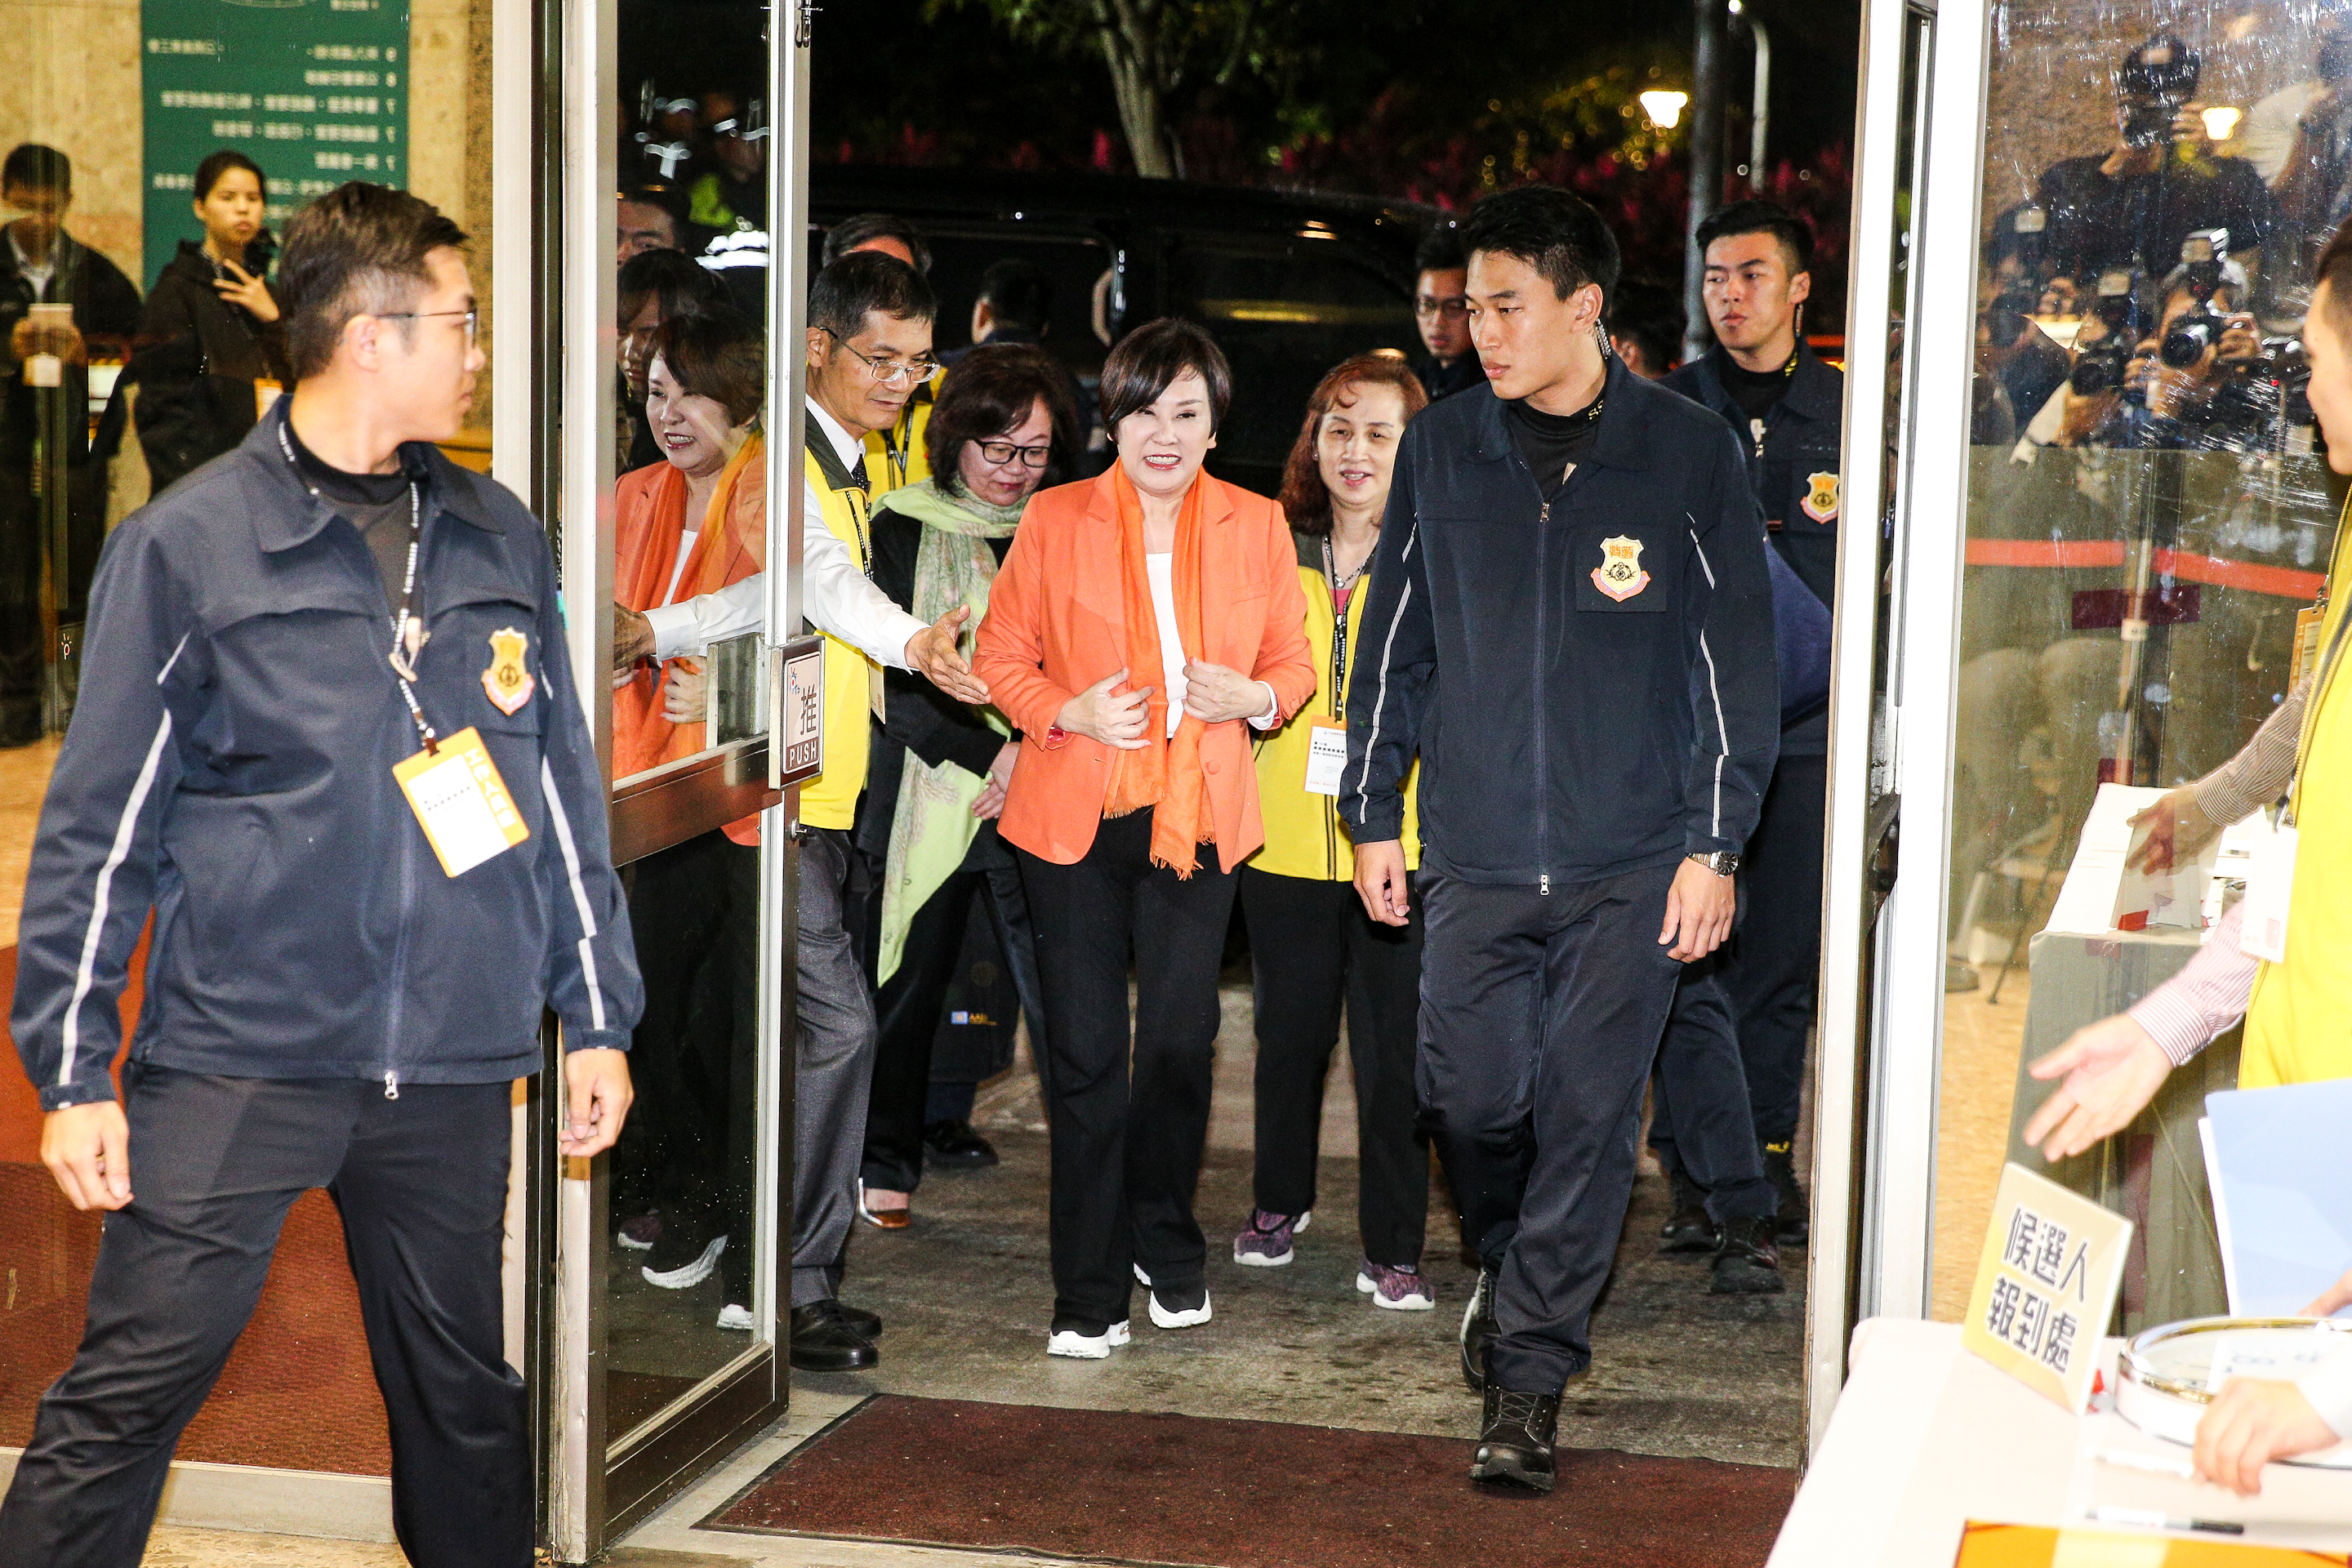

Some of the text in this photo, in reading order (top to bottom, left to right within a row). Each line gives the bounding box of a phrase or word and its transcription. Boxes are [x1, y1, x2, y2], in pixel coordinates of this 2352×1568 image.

[800, 684, 817, 736] 推
[789, 740, 817, 768] PUSH
[2003, 1206, 2088, 1303] 候選人
[1988, 1275, 2078, 1374] 報到處
